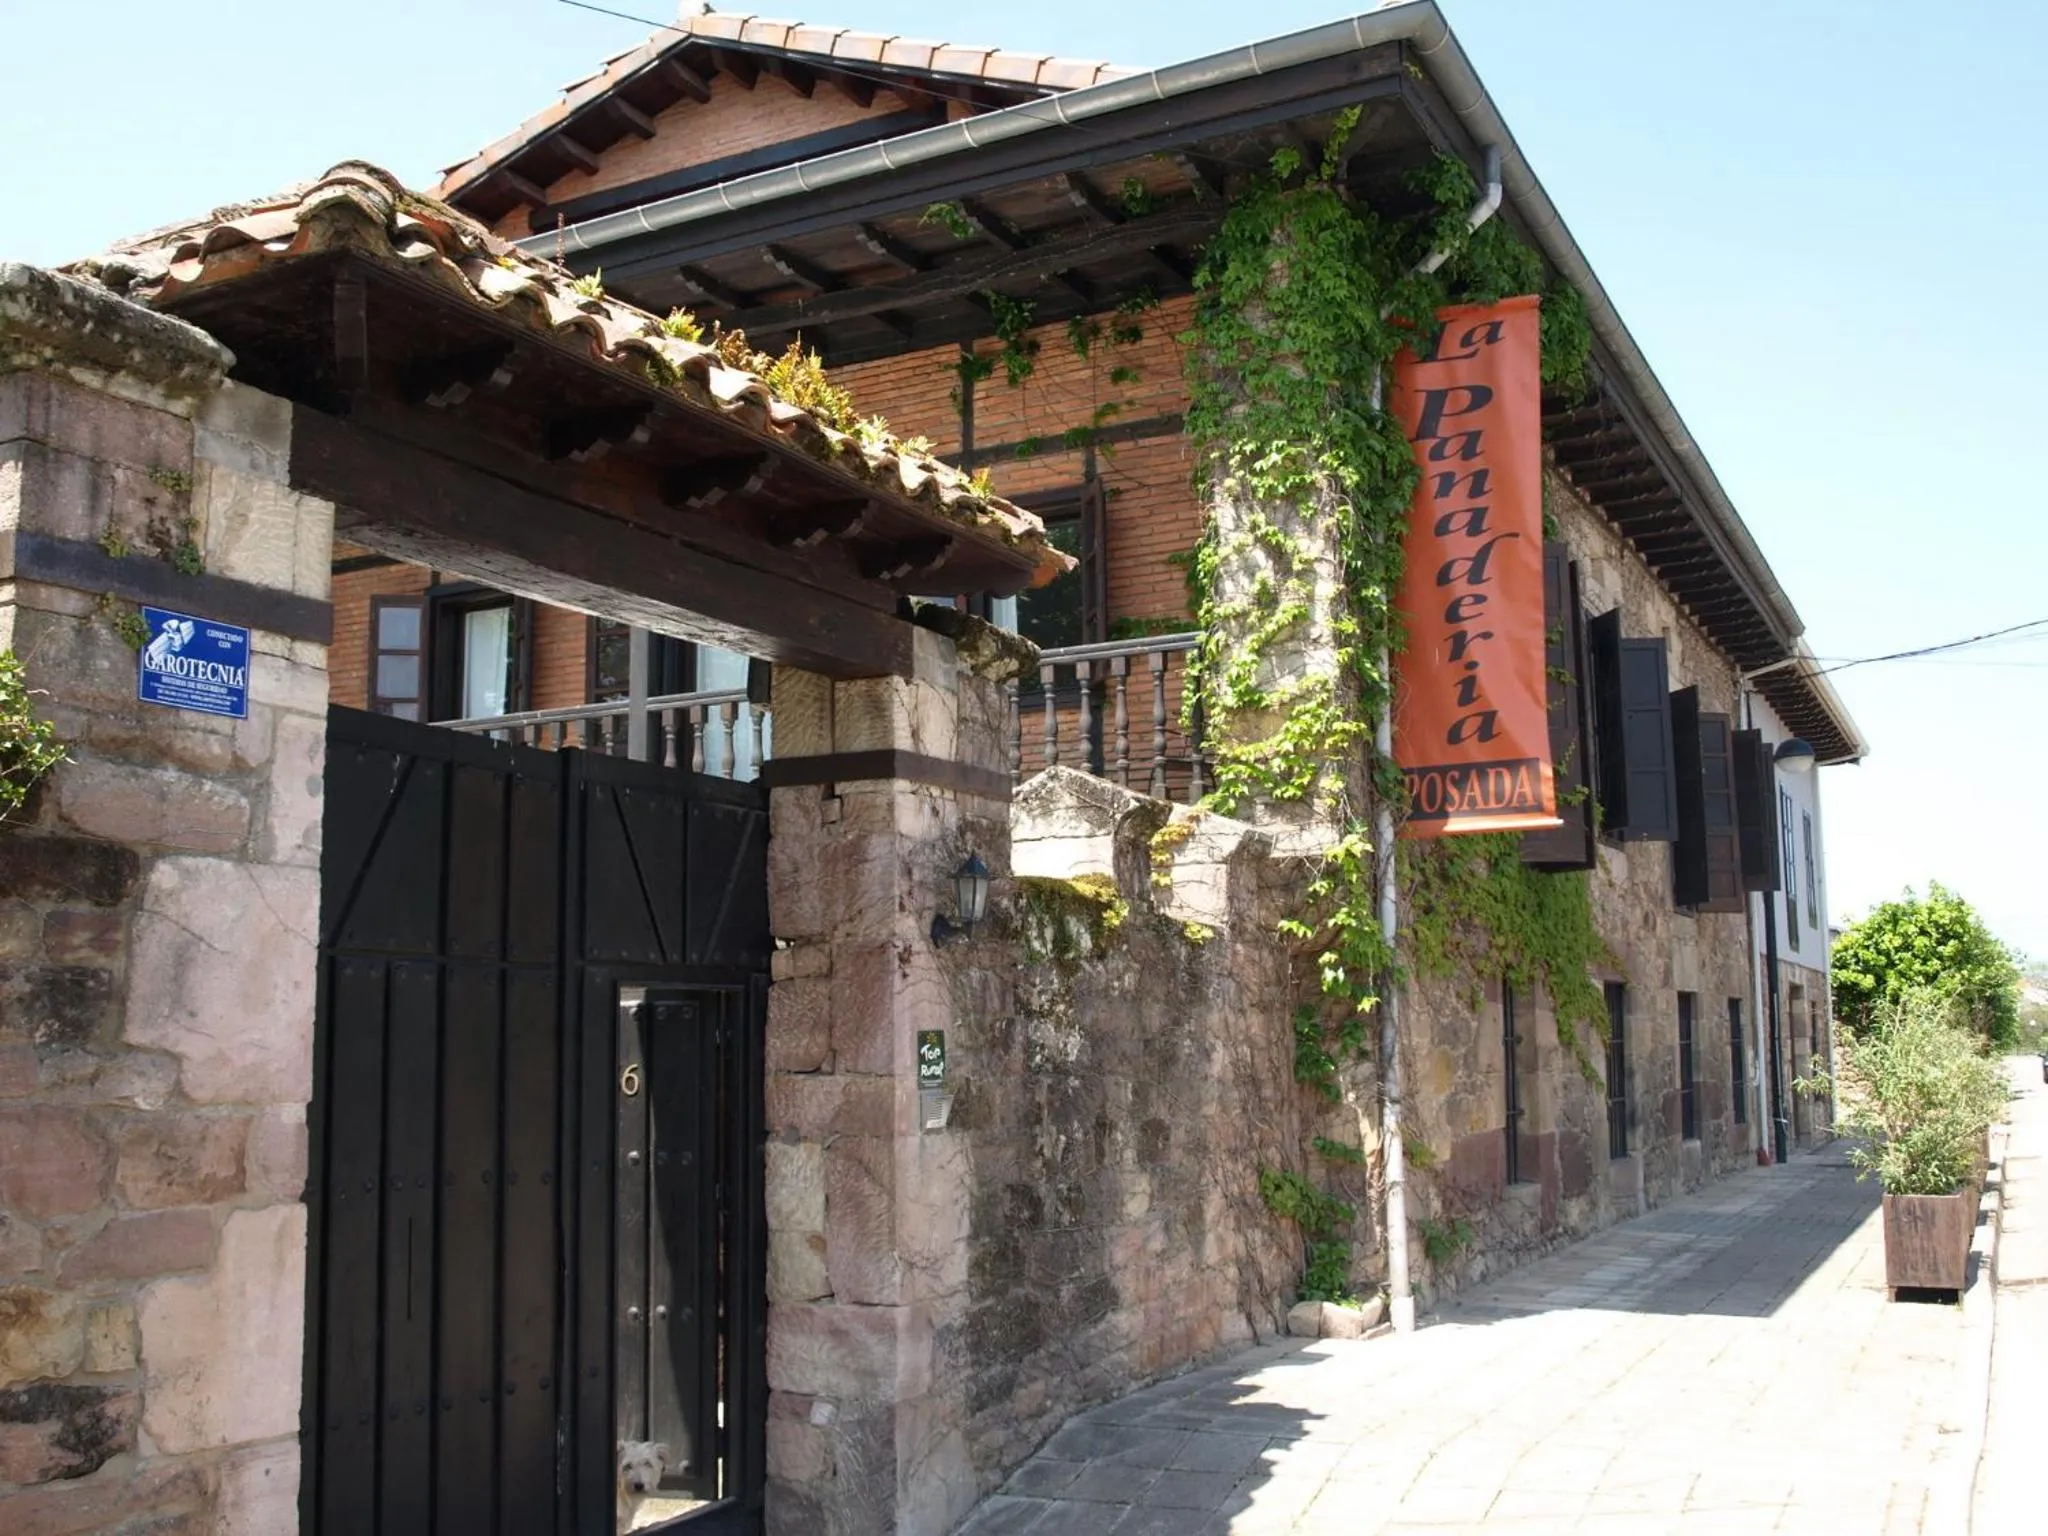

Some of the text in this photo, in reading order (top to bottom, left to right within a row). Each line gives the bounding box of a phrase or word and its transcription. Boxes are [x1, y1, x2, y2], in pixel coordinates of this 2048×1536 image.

[1409, 319, 1505, 365] La
[1405, 765, 1537, 814] POSADA
[622, 1064, 639, 1095] 6
